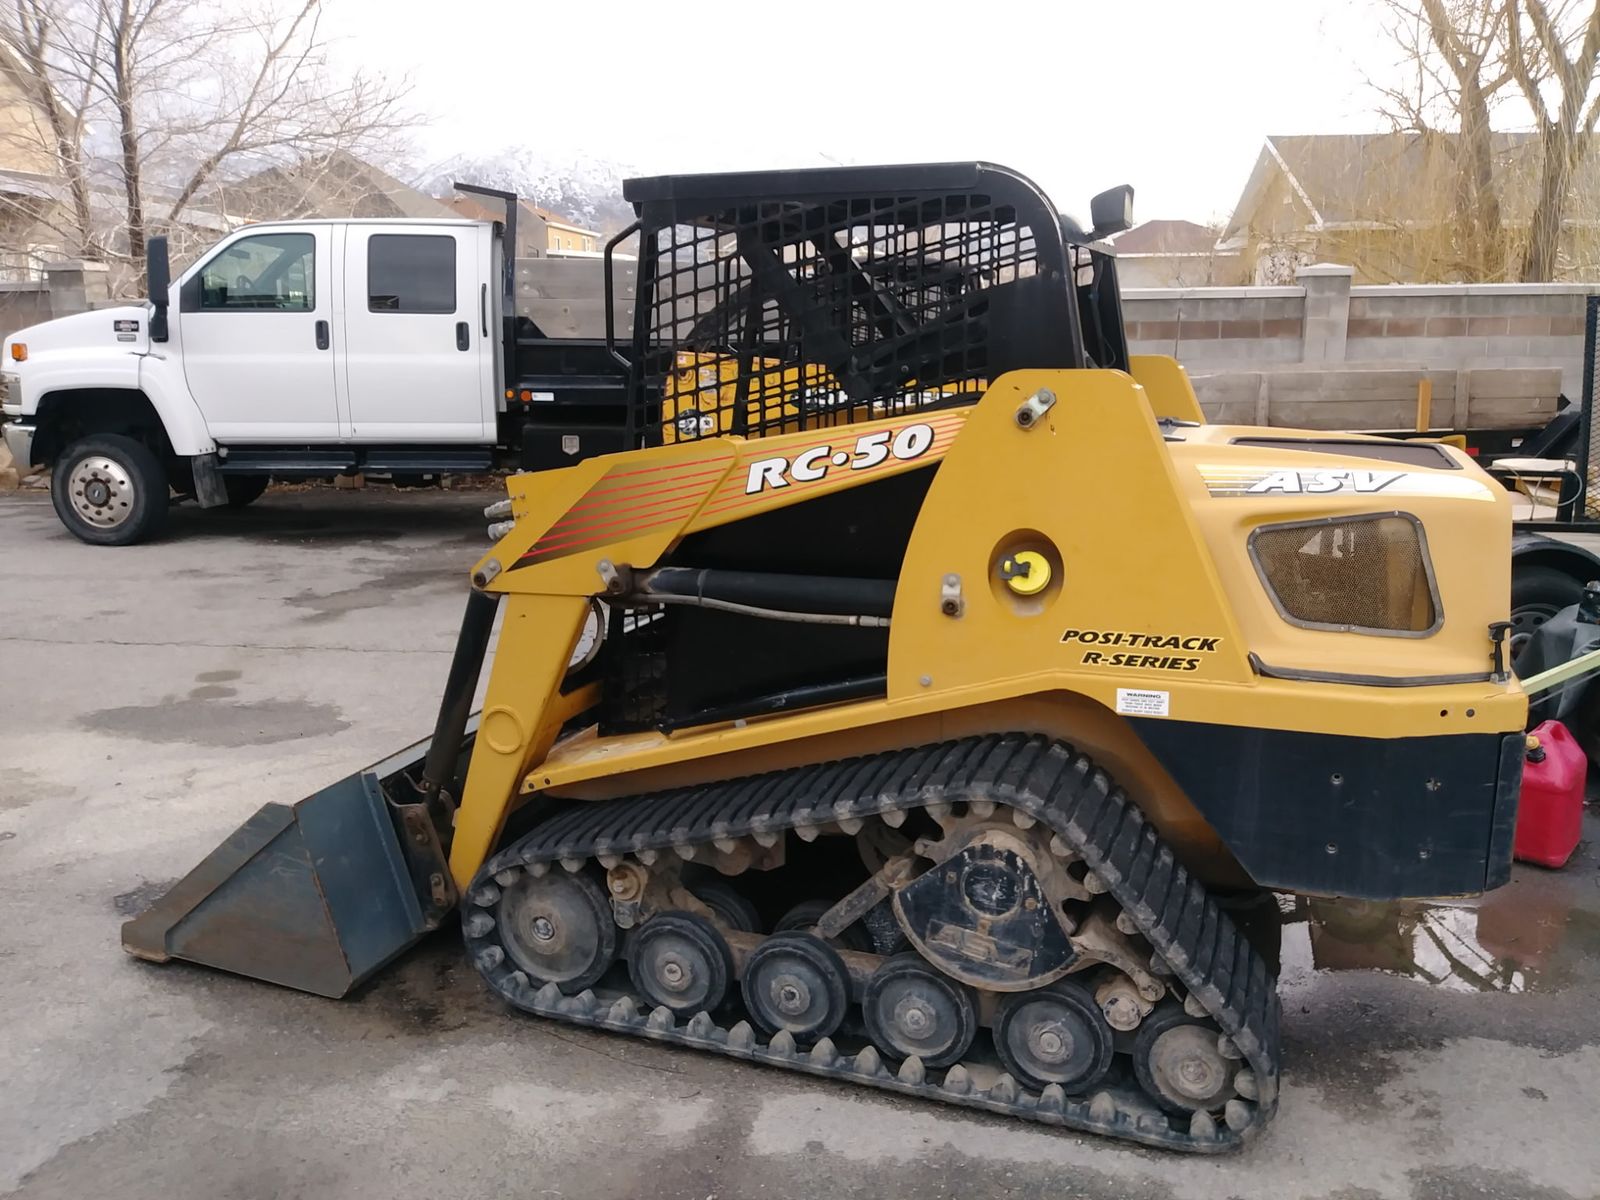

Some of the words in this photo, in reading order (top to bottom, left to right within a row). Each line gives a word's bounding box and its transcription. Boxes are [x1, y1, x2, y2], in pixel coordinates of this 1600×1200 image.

[1246, 470, 1407, 493] ASV
[1061, 630, 1220, 651] POSI-TRACK
[1082, 652, 1200, 671] R-SERIES
